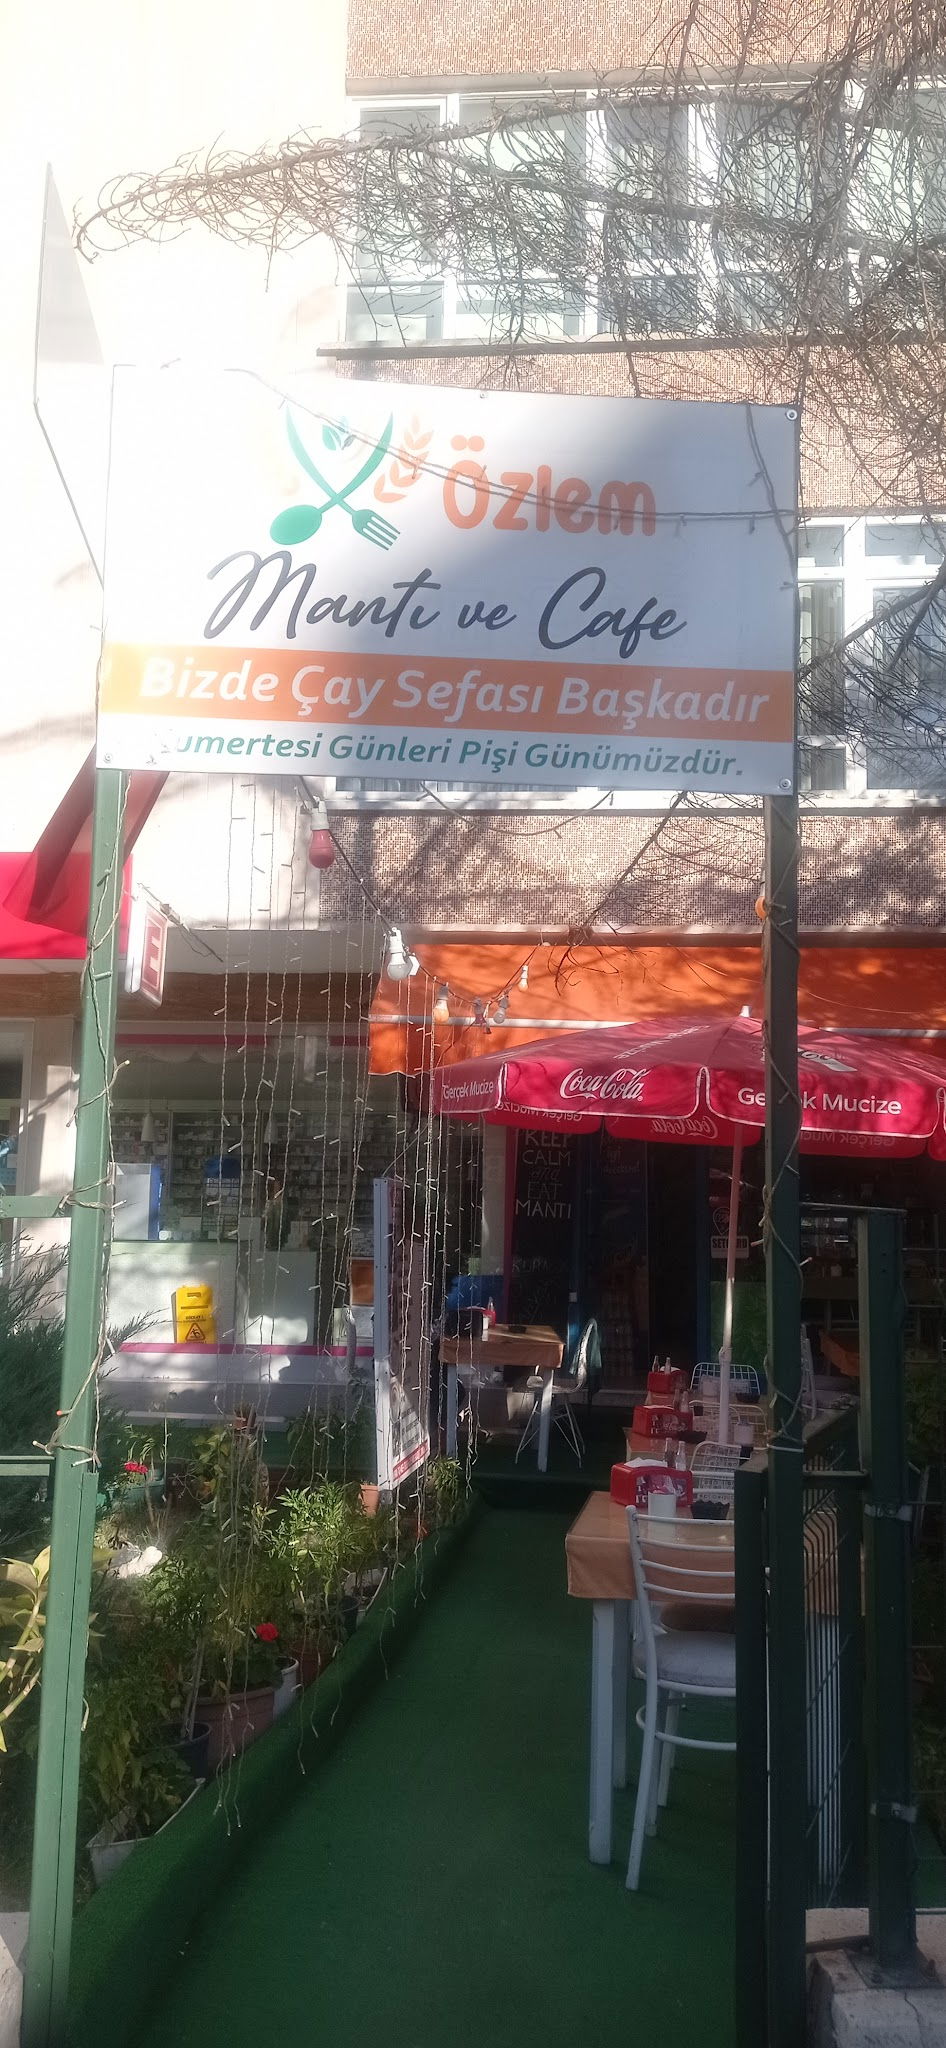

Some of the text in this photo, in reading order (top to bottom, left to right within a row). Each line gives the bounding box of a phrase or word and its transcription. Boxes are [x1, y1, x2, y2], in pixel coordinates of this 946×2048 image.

[443, 434, 656, 537] Özlem
[203, 550, 687, 659] Mantı ve Cafe
[138, 656, 770, 730] Bizde Çay Sefası Başkadır
[160, 731, 744, 776] umertesi Günleri Pişi Günümüzdür.
[442, 1079, 494, 1103] Gerçek Mucize
[559, 1068, 652, 1101] Coca-Cola
[738, 1087, 902, 1116] Gek Mucize
[522, 1149, 571, 1166] CALM
[527, 1182, 563, 1200] EAT
[515, 1199, 572, 1219] MANTI
